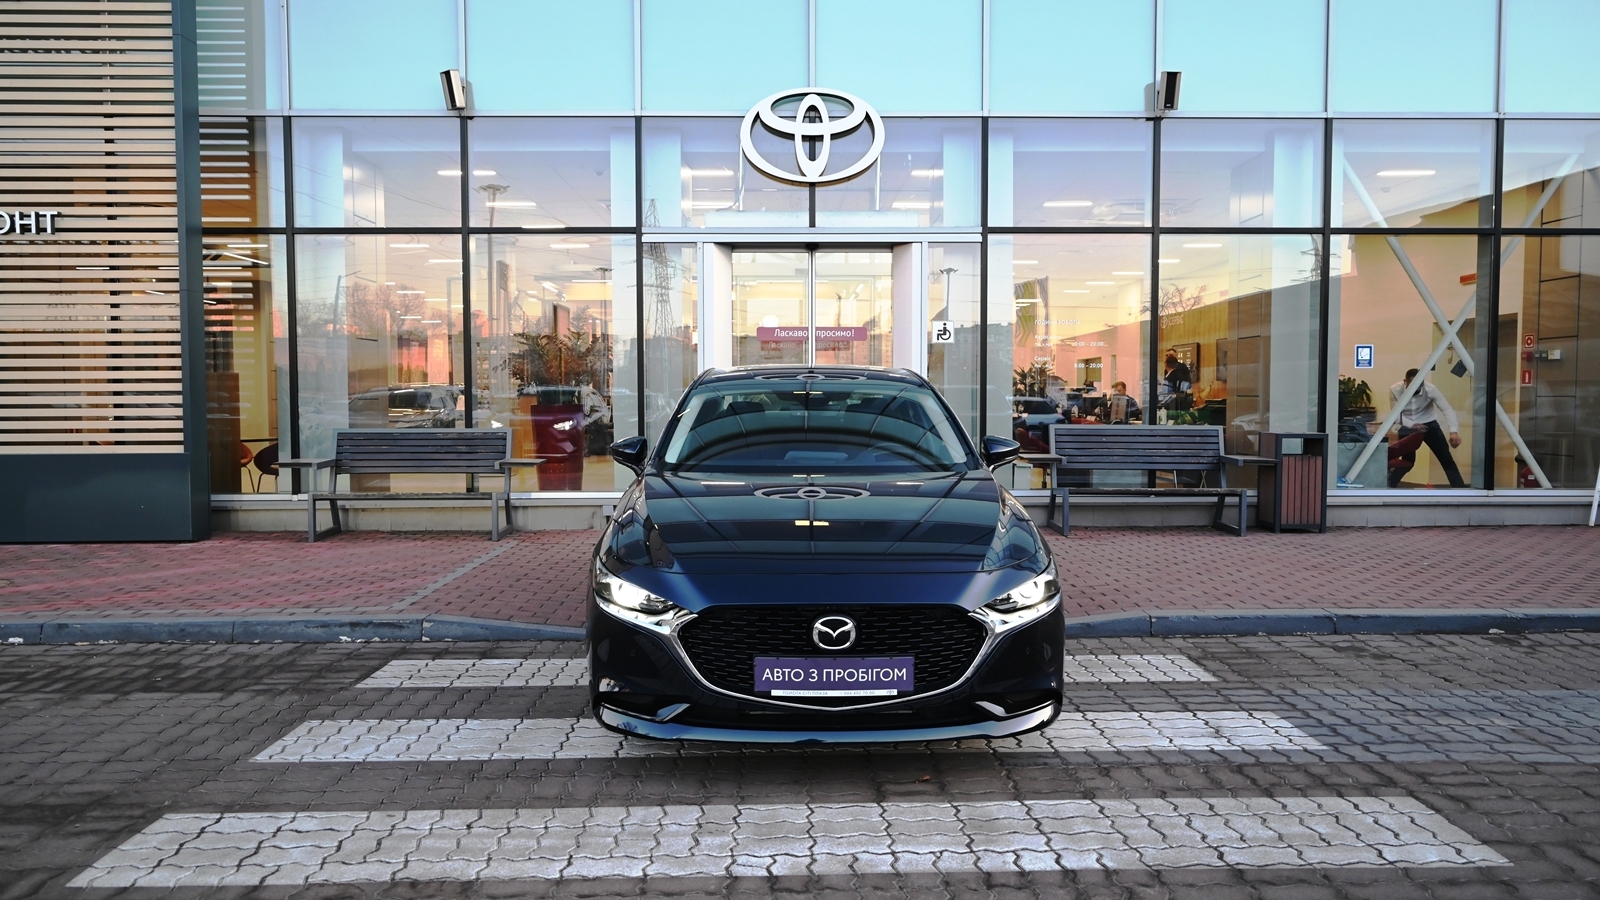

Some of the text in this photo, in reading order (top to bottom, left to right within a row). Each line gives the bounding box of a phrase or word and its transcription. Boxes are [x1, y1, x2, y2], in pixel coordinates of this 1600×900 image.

[774, 328, 855, 339] Ласкаво просимо!
[762, 668, 805, 682] АВТО
[823, 667, 907, 682] ПРОБІГОМ
